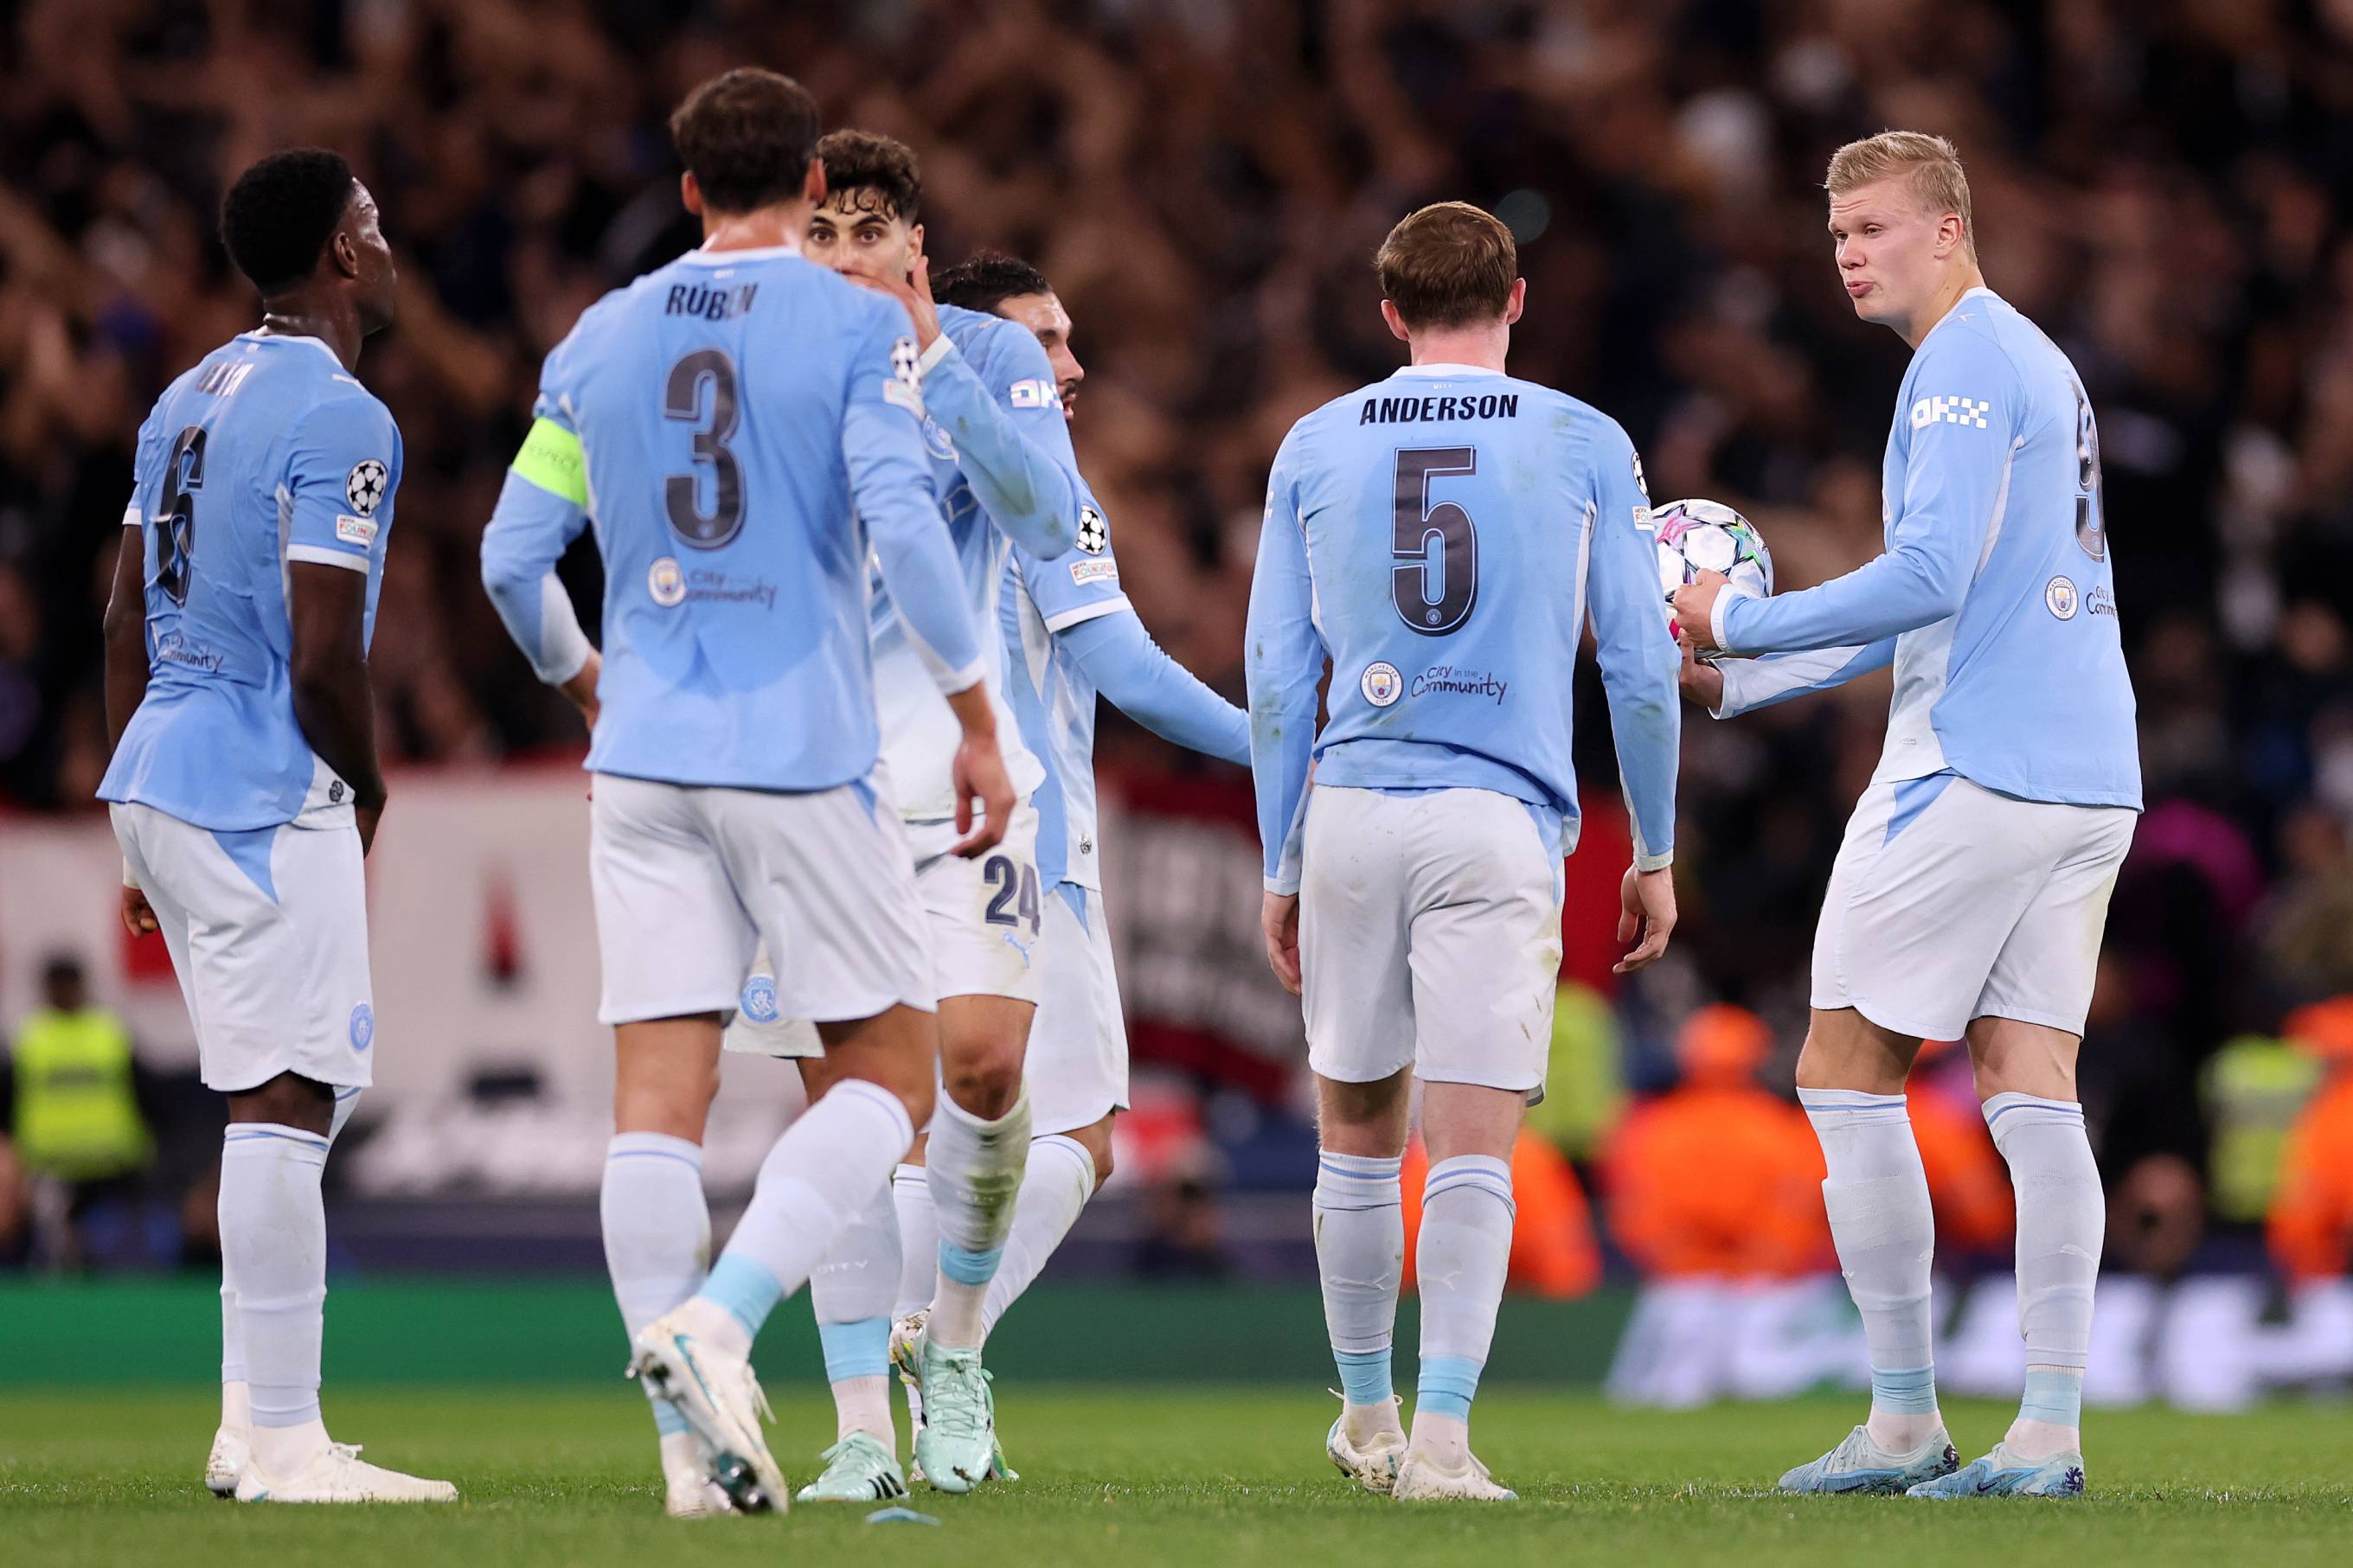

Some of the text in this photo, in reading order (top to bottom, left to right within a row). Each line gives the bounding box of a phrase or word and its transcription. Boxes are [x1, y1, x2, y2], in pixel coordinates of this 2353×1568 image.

[1010, 379, 1064, 409] OK
[1360, 394, 1519, 426] ANDERSON
[1911, 395, 1990, 431] OKX
[665, 347, 746, 550] 3
[2072, 381, 2104, 563] 9
[155, 425, 206, 607] 6
[1391, 445, 1478, 637] 5
[683, 577, 778, 611] ommunity
[1364, 664, 1398, 678] MANCHESTER
[1427, 666, 1452, 679] City
[1411, 672, 1508, 706] Community
[984, 854, 1041, 936] 24
